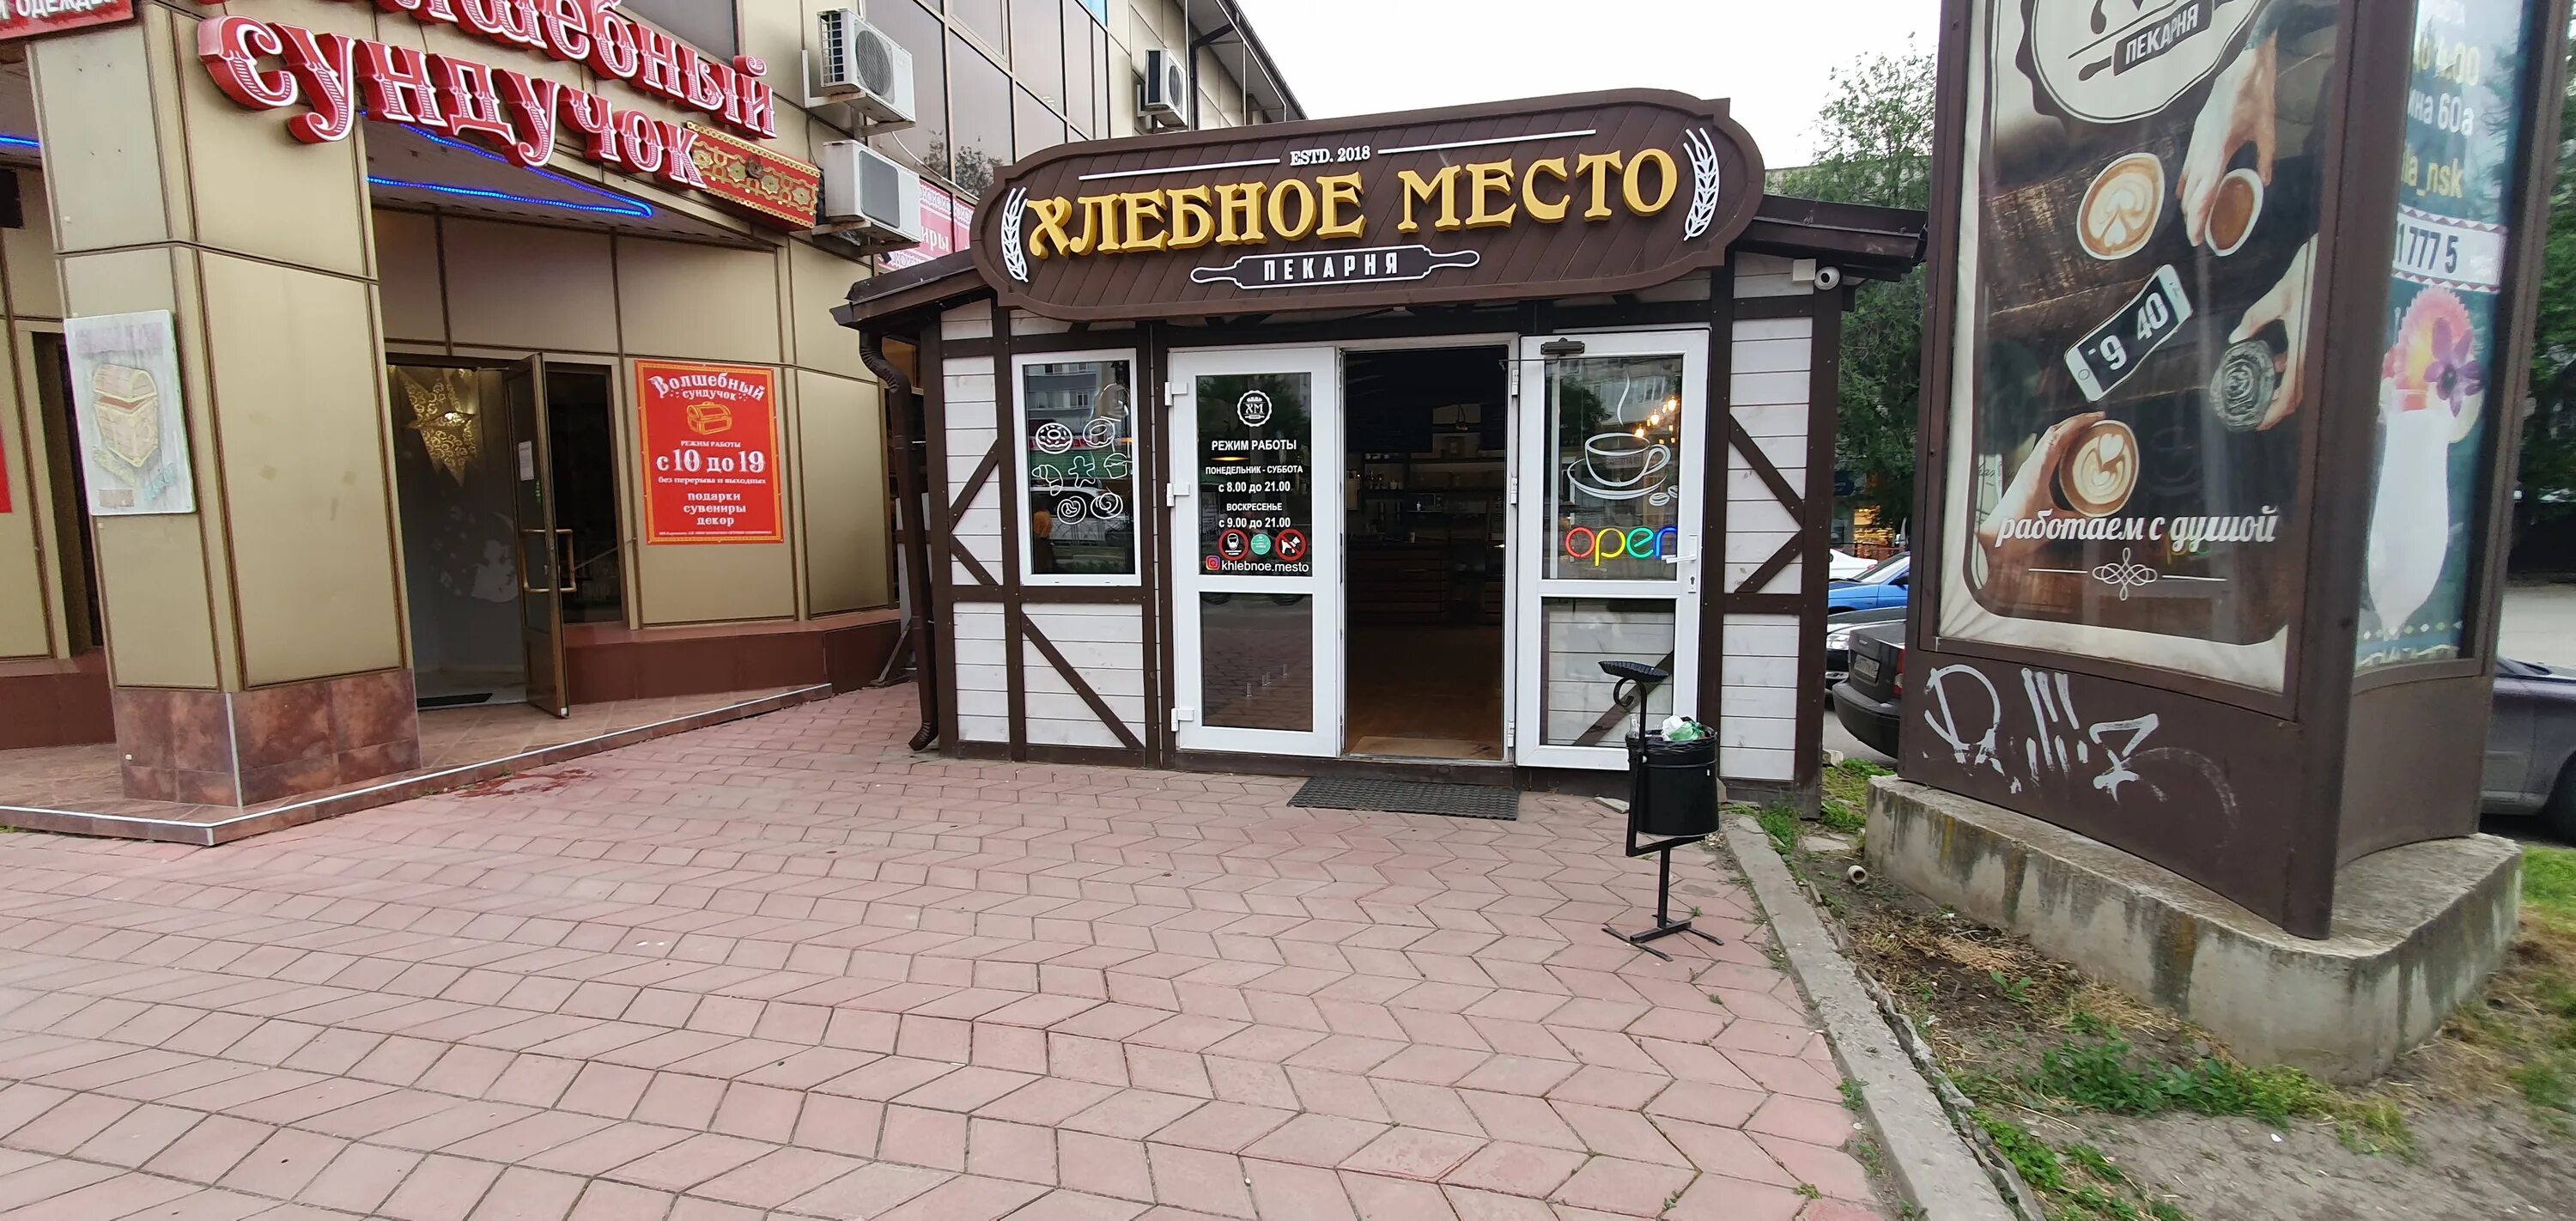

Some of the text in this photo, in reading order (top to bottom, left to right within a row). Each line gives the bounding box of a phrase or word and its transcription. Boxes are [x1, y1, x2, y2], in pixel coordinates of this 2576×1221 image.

[2124, 3, 2199, 65] ПЕКАРНЯ
[199, 15, 708, 188] сундучок
[2437, 92, 2474, 136] 60а
[1290, 145, 1371, 166] ESTD. 2018
[1026, 148, 1679, 259] ХЛЕБНОЕ МЕСТО
[1264, 252, 1398, 282] ПЕКАРНЯ
[2099, 292, 2169, 370] 9 40
[647, 372, 766, 401] Волшебный
[682, 389, 737, 401] сундучок
[1211, 439, 1297, 451] РЕЖИМ РАБОТЫ
[673, 449, 702, 472] 10
[707, 457, 734, 473] до
[738, 450, 765, 473] 19
[1205, 466, 1261, 475] ПОНЕДЕЛЬНИК
[1267, 465, 1303, 474] СУББОТА
[1218, 480, 1291, 494] с 8.00 до 21.00
[687, 492, 741, 503] подарки
[683, 504, 746, 515] сувениры
[1226, 502, 1283, 512] ВОСКРЕСЕНЬЕ
[696, 516, 735, 526] декор
[1218, 517, 1291, 529] с 9.00 до 21.00
[1994, 504, 2279, 553] работаем с душой
[1221, 560, 1309, 573] khlebnoe.mesto
